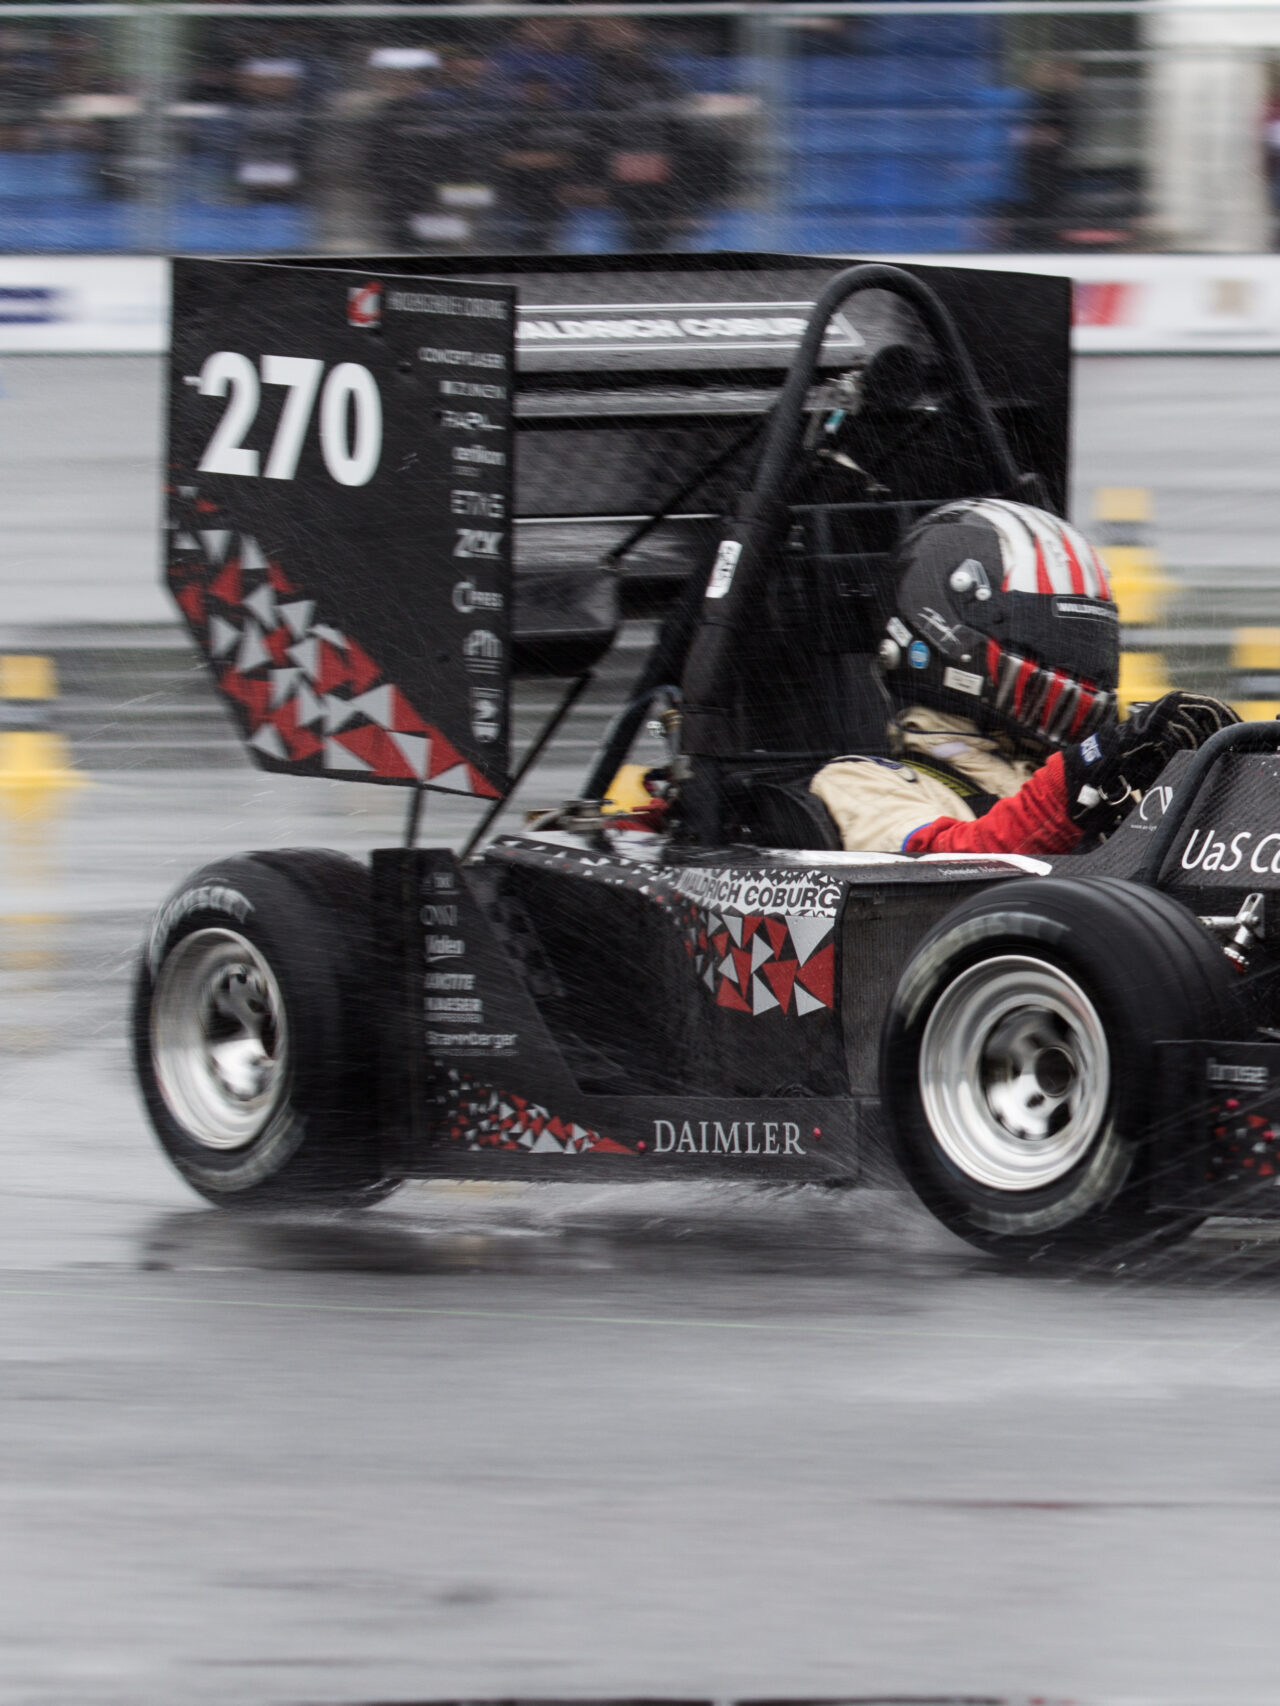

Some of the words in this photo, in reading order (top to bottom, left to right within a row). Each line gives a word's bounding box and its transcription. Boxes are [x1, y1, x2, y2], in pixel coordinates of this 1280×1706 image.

[515, 318, 683, 338] ALDRICH
[197, 351, 385, 489] 270
[1181, 829, 1251, 872] UaS
[743, 885, 842, 909] COBURG
[653, 1120, 807, 1155] DAIMLER
